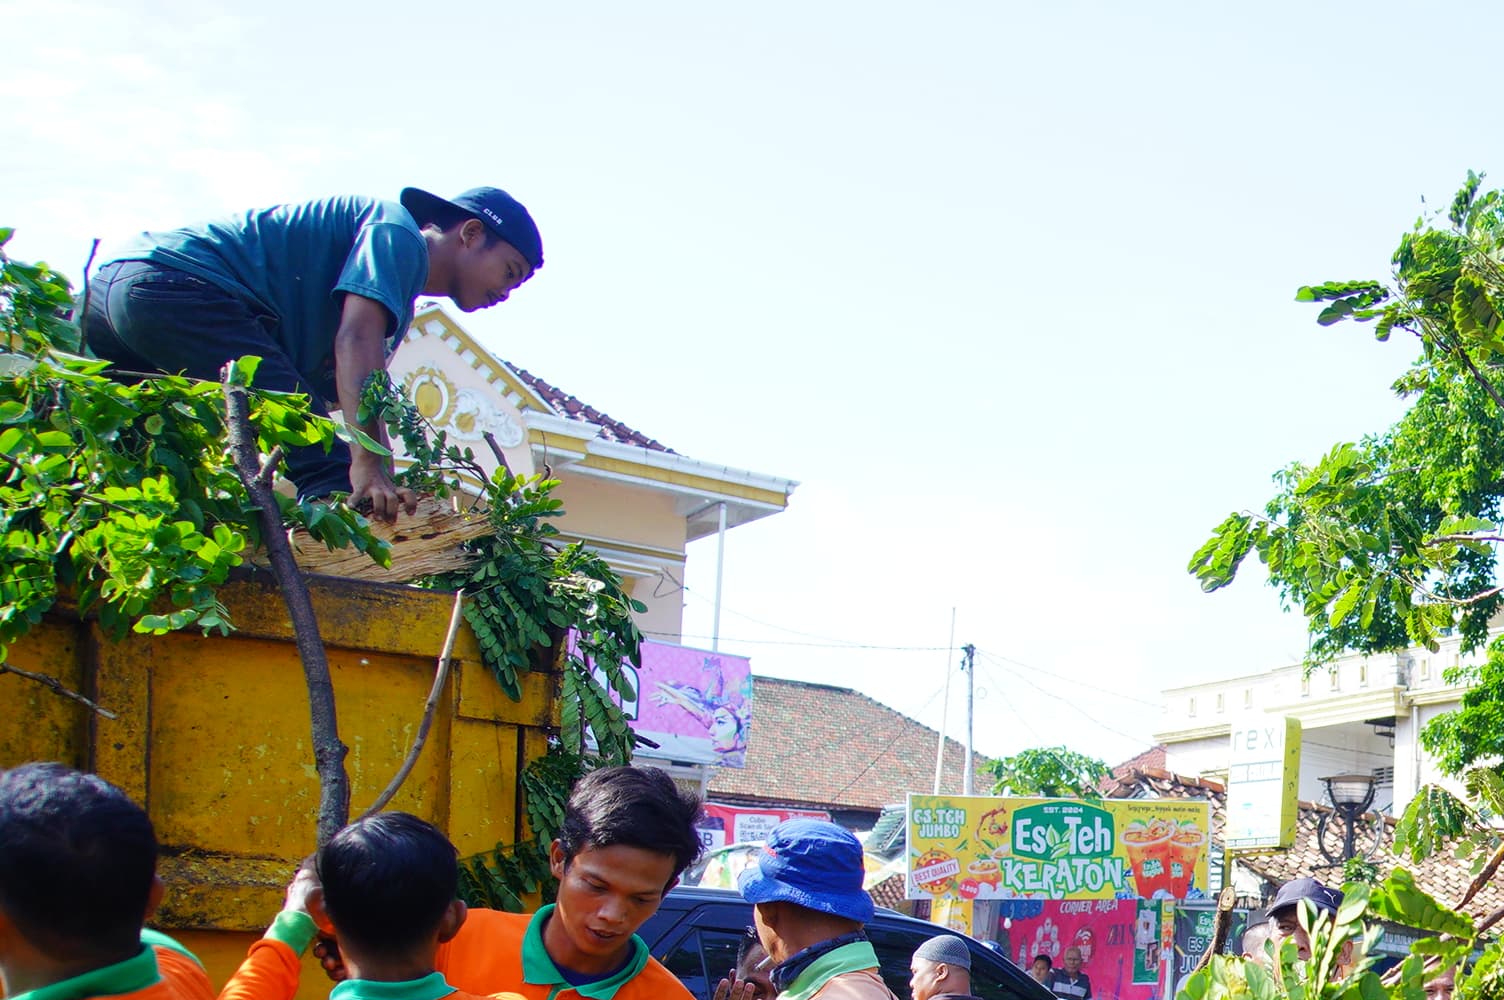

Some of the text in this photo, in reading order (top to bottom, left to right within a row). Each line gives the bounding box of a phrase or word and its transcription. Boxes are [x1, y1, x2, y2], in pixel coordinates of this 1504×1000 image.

[913, 809, 965, 825] ES TEH
[919, 824, 960, 838] JUMBO
[1015, 816, 1111, 855] Es Teh
[913, 861, 957, 882] BEST QUALITY
[1002, 858, 1123, 899] KERATON
[1059, 900, 1119, 915] CORNER AREA
[1187, 937, 1205, 953] ES
